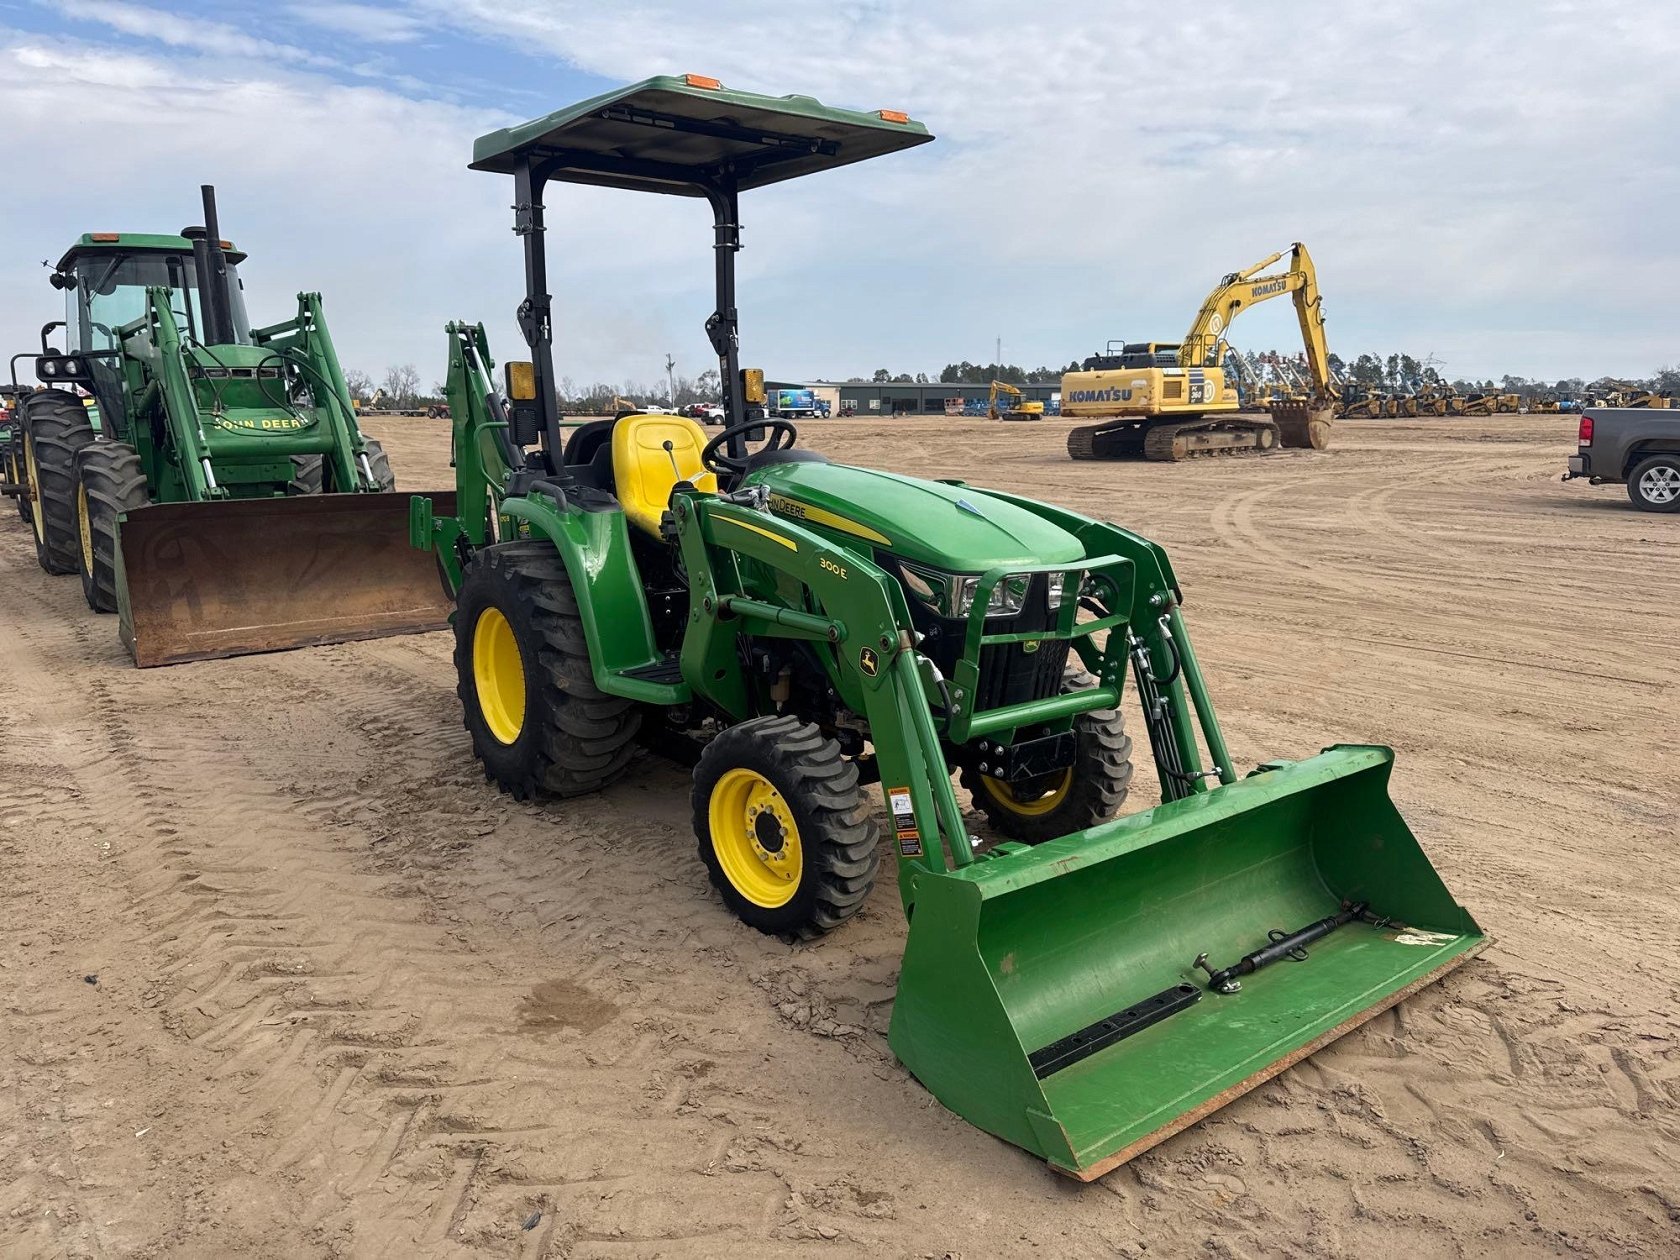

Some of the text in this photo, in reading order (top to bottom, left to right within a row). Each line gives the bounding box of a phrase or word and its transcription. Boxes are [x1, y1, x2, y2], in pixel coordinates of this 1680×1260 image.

[1252, 280, 1287, 298] KOMATSU
[1069, 386, 1132, 402] KOMATSU
[262, 419, 304, 429] DEER
[780, 499, 806, 519] DEERE
[820, 557, 848, 580] 300E
